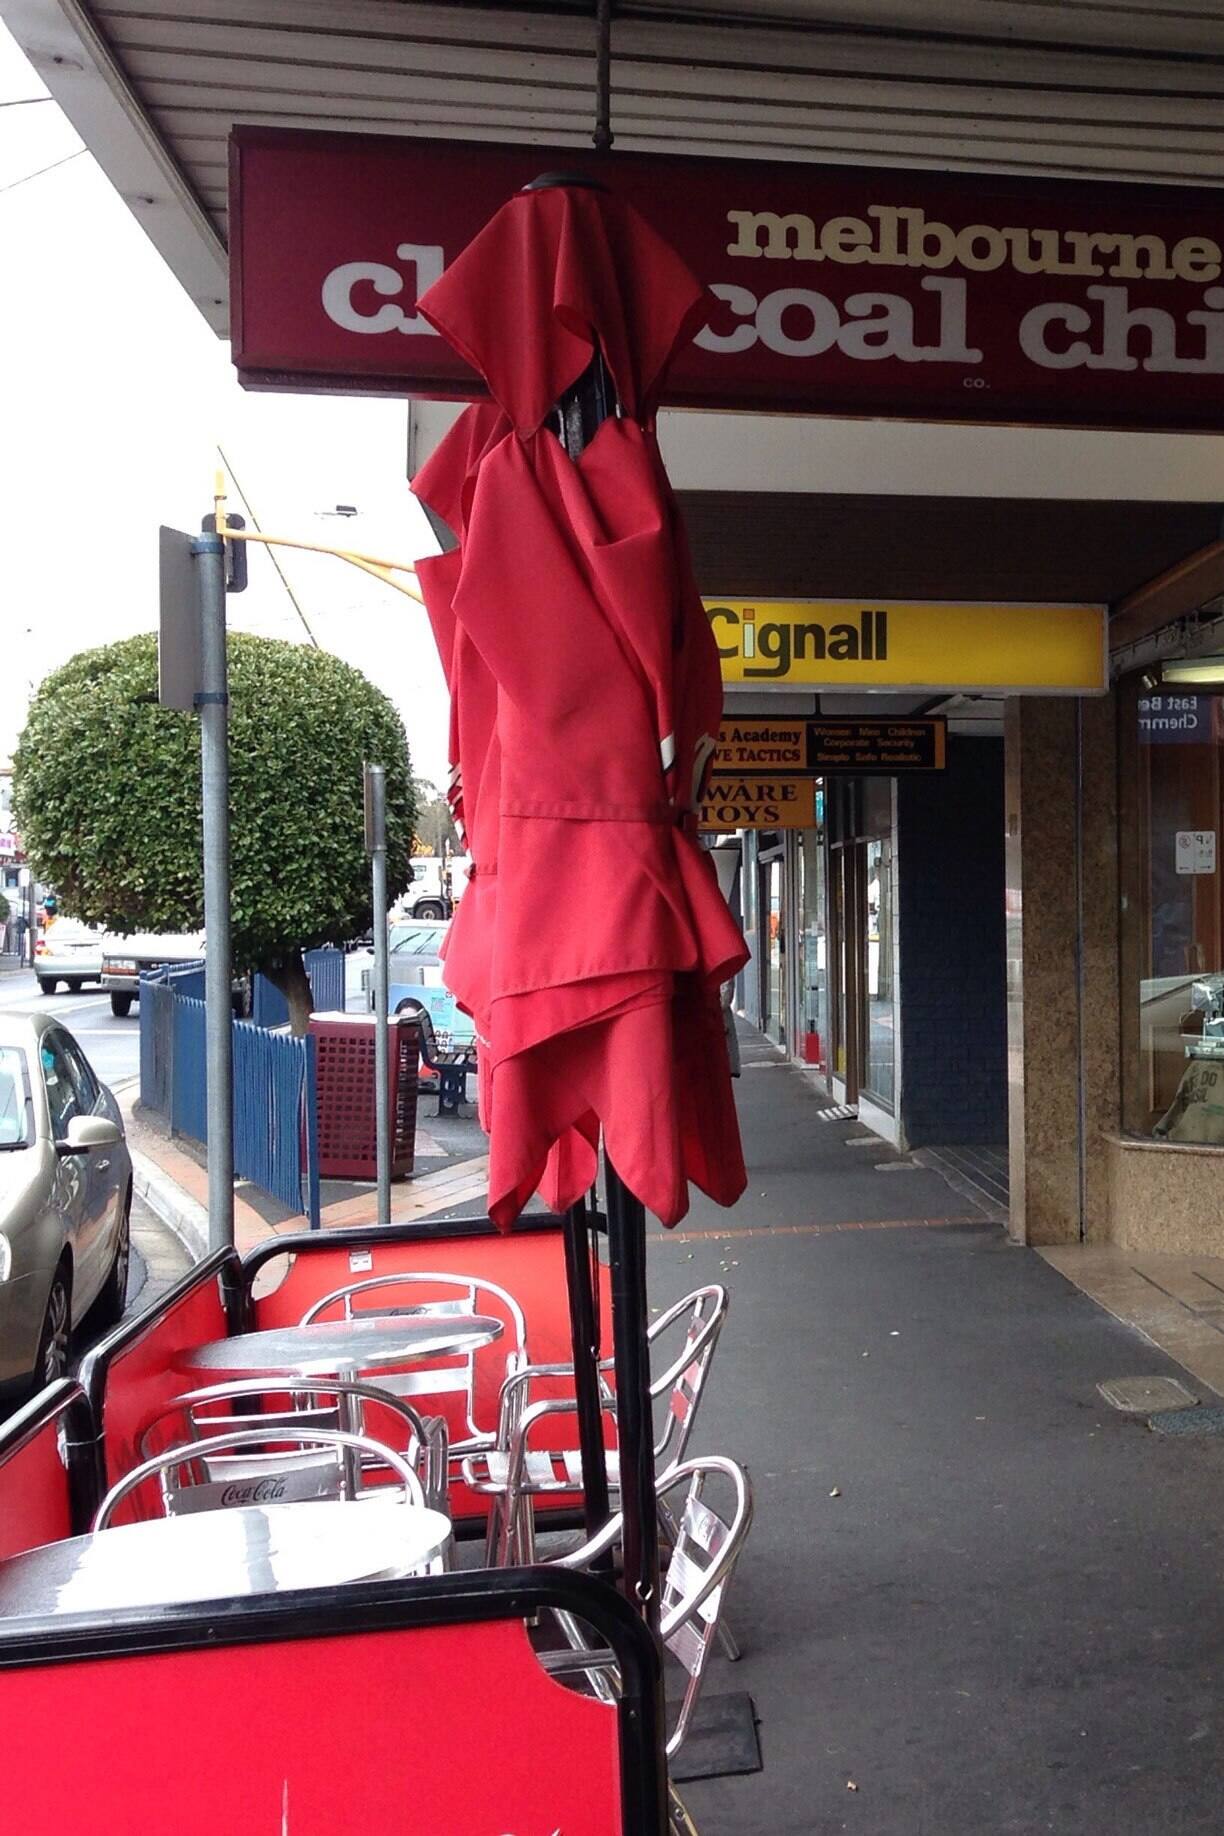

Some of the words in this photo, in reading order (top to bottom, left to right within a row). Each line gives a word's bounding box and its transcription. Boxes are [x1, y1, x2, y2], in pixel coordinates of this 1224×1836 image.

[726, 204, 1223, 284] melbourne
[706, 606, 888, 678] Cignall
[731, 728, 801, 745] Academy
[813, 727, 850, 736] Women
[858, 728, 880, 736] Men
[887, 727, 926, 736] Children
[823, 738, 870, 748] Corporate
[877, 738, 915, 748] Security
[701, 805, 780, 823] TOYS
